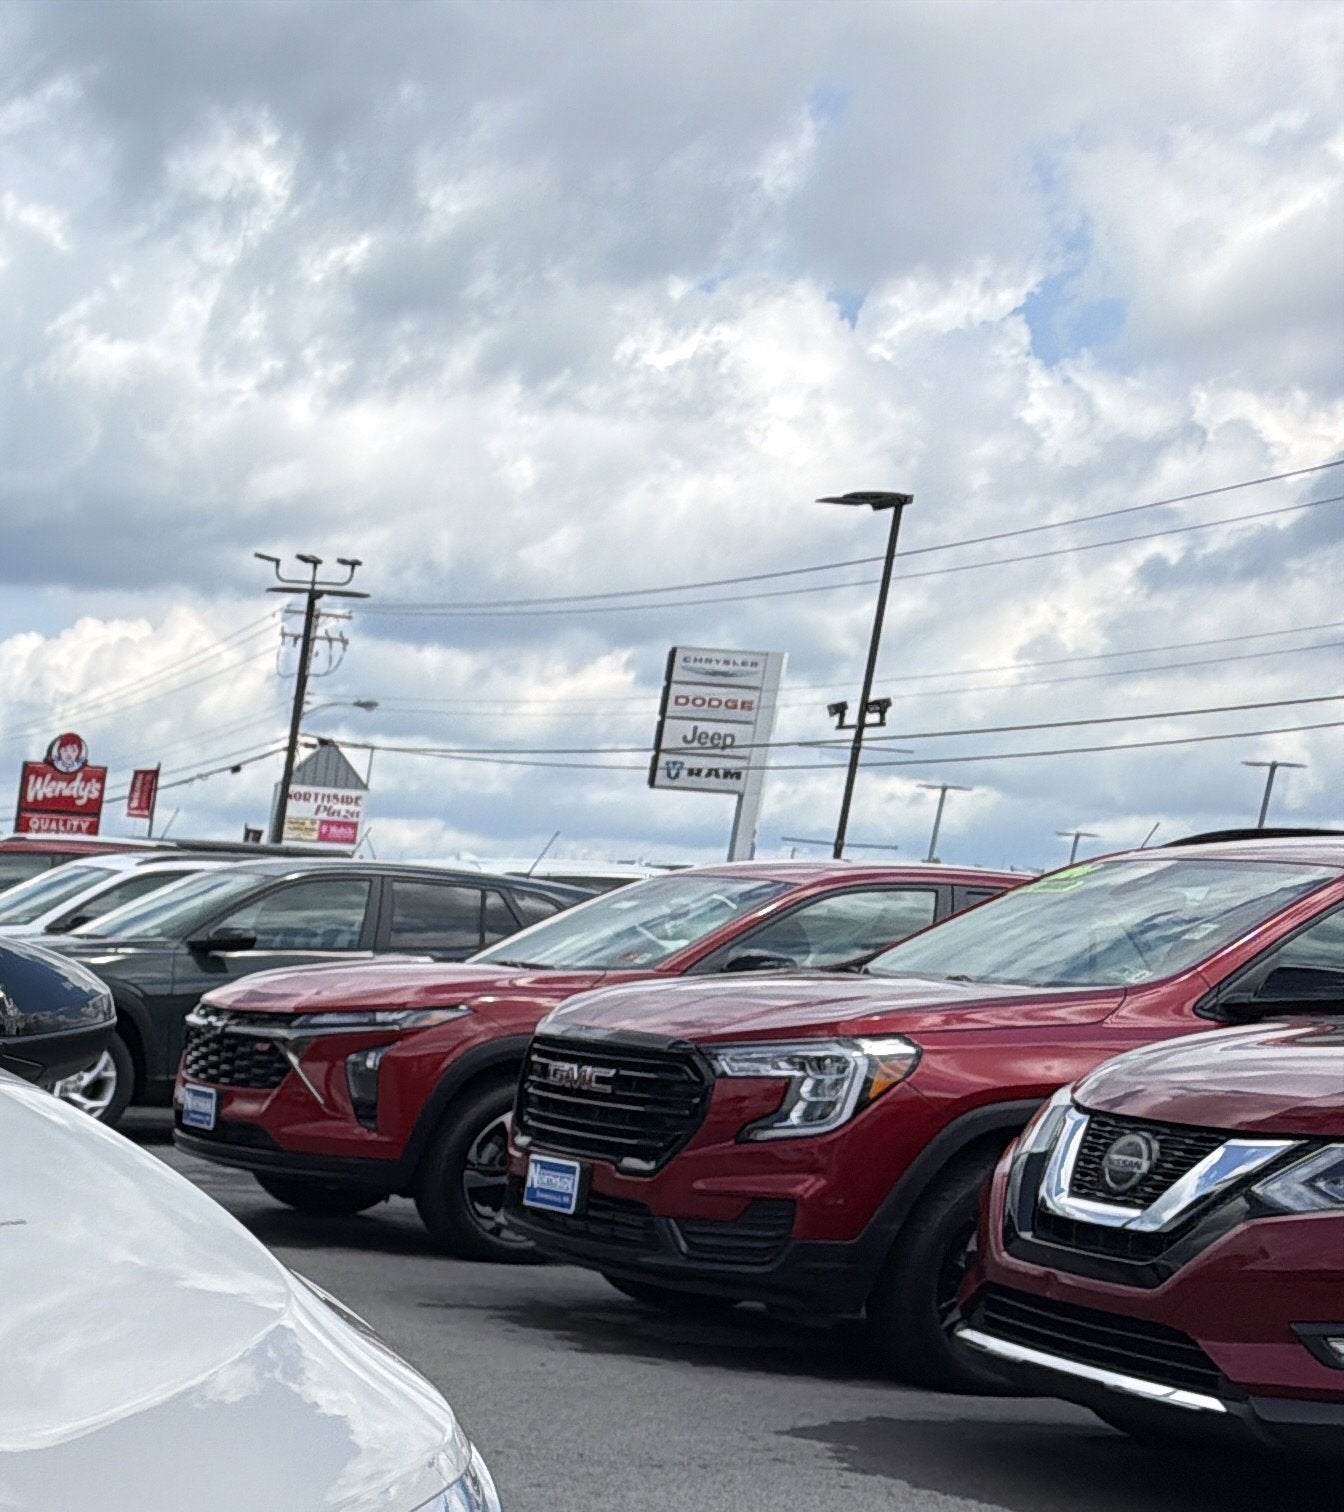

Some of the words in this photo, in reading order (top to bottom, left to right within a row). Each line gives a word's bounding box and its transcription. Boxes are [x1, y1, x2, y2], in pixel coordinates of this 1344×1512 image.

[682, 656, 759, 668] CHRYSLER
[674, 695, 754, 712] DODGE
[682, 725, 736, 751] Jeep
[26, 772, 101, 806] Wendy's
[29, 818, 91, 833] QUALITY
[548, 1063, 617, 1094] GMC
